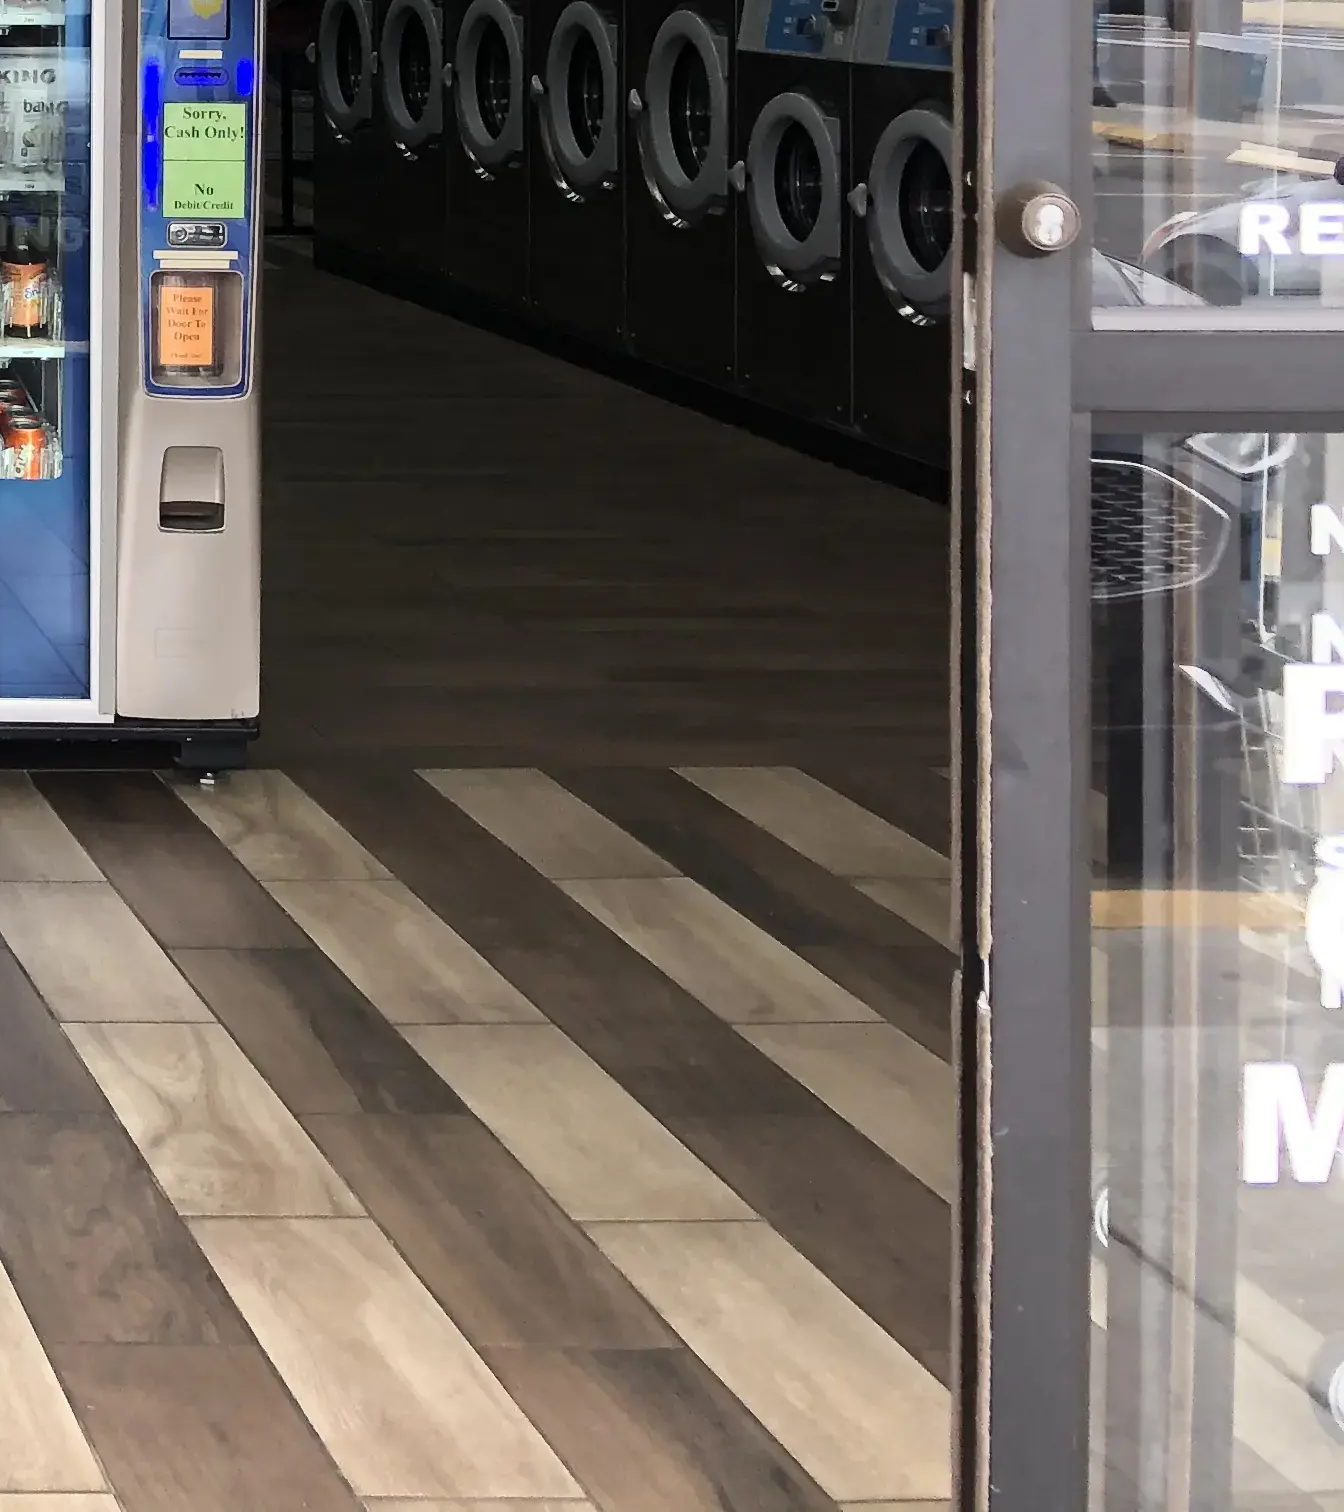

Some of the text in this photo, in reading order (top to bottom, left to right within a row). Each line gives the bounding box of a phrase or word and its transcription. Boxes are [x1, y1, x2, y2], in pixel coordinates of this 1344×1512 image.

[164, 125, 244, 142] Cash Only!
[194, 183, 215, 196] No
[174, 200, 234, 210] Debit/Credit
[172, 293, 203, 303] Please
[166, 306, 189, 316] Wait
[167, 319, 193, 328] Door
[173, 331, 200, 343] Open
